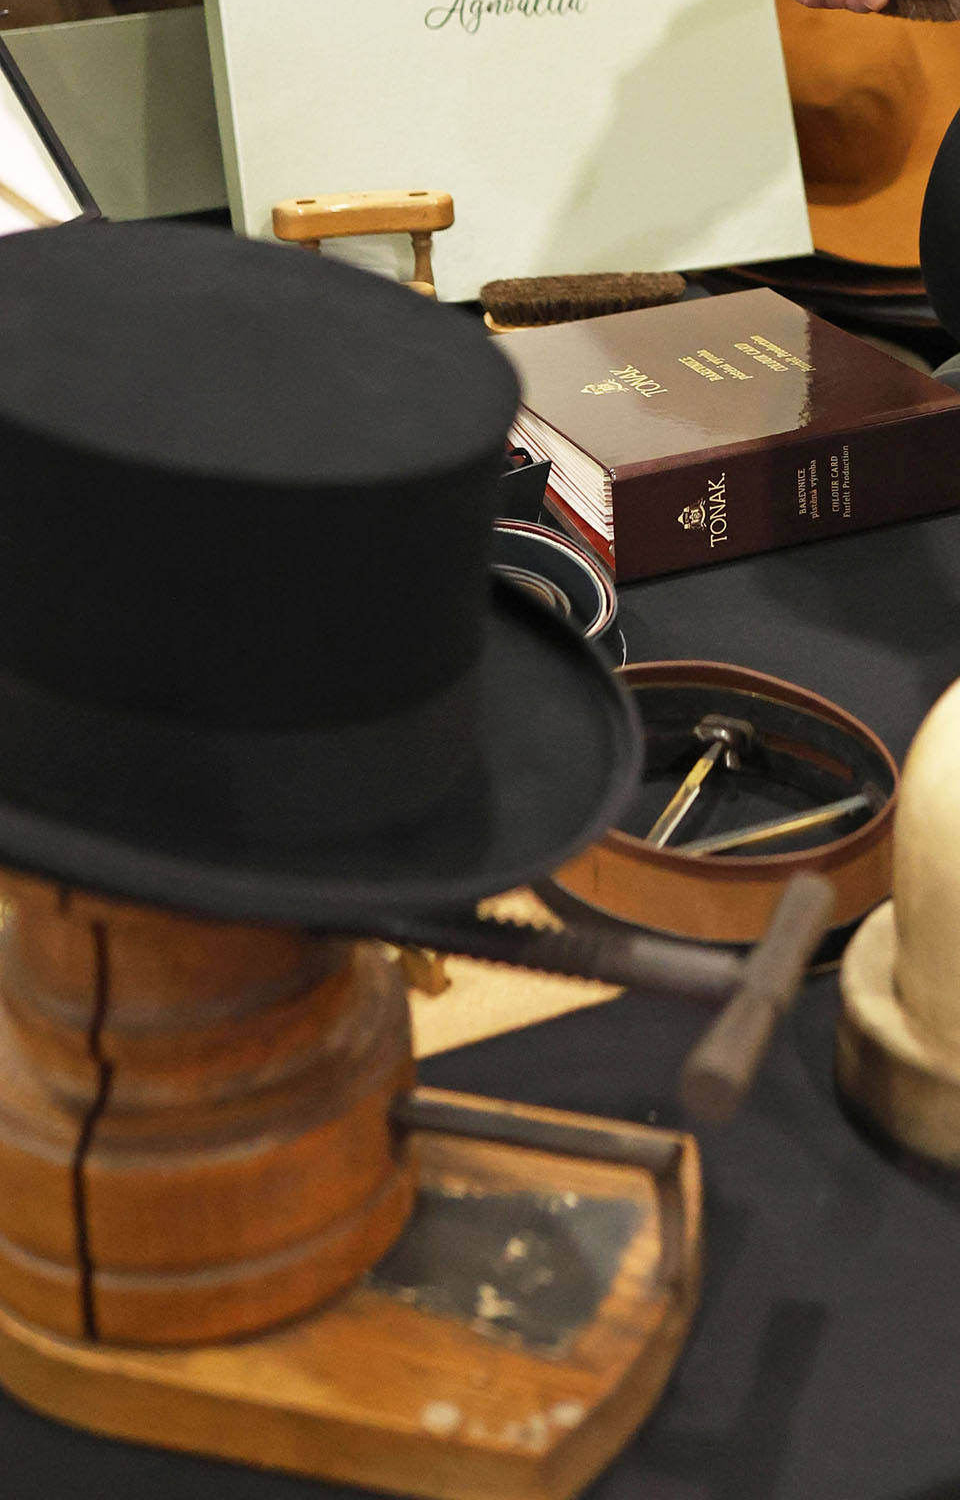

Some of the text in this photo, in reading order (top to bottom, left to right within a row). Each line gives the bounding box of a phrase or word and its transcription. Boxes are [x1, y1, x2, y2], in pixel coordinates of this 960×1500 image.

[608, 364, 668, 398] TONAK
[797, 467, 807, 516] BAREVNICE
[830, 455, 840, 512] COLOUR CARD
[841, 445, 851, 518] Furfelt Production
